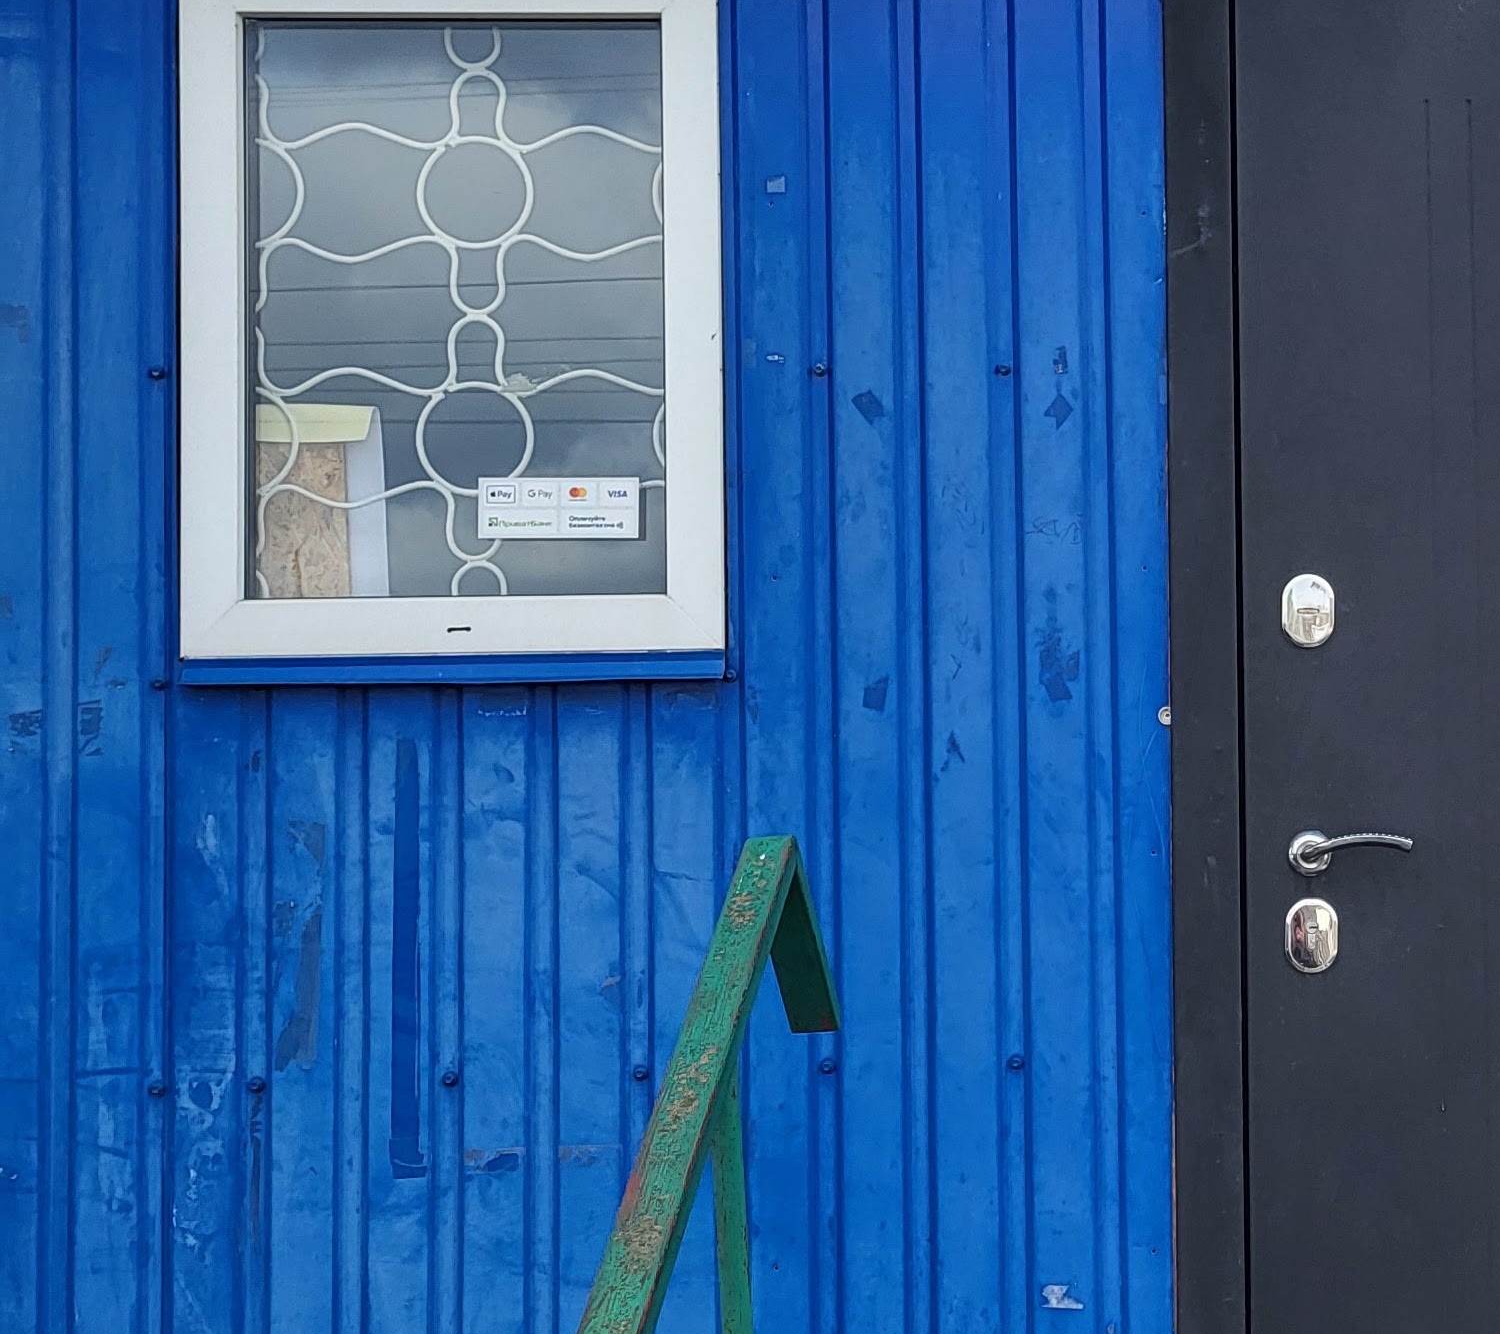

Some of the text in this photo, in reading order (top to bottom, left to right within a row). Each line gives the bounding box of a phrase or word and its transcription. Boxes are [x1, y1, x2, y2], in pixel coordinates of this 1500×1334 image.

[497, 490, 512, 499] Pay
[537, 489, 552, 500] Pay
[608, 490, 628, 498] VISA
